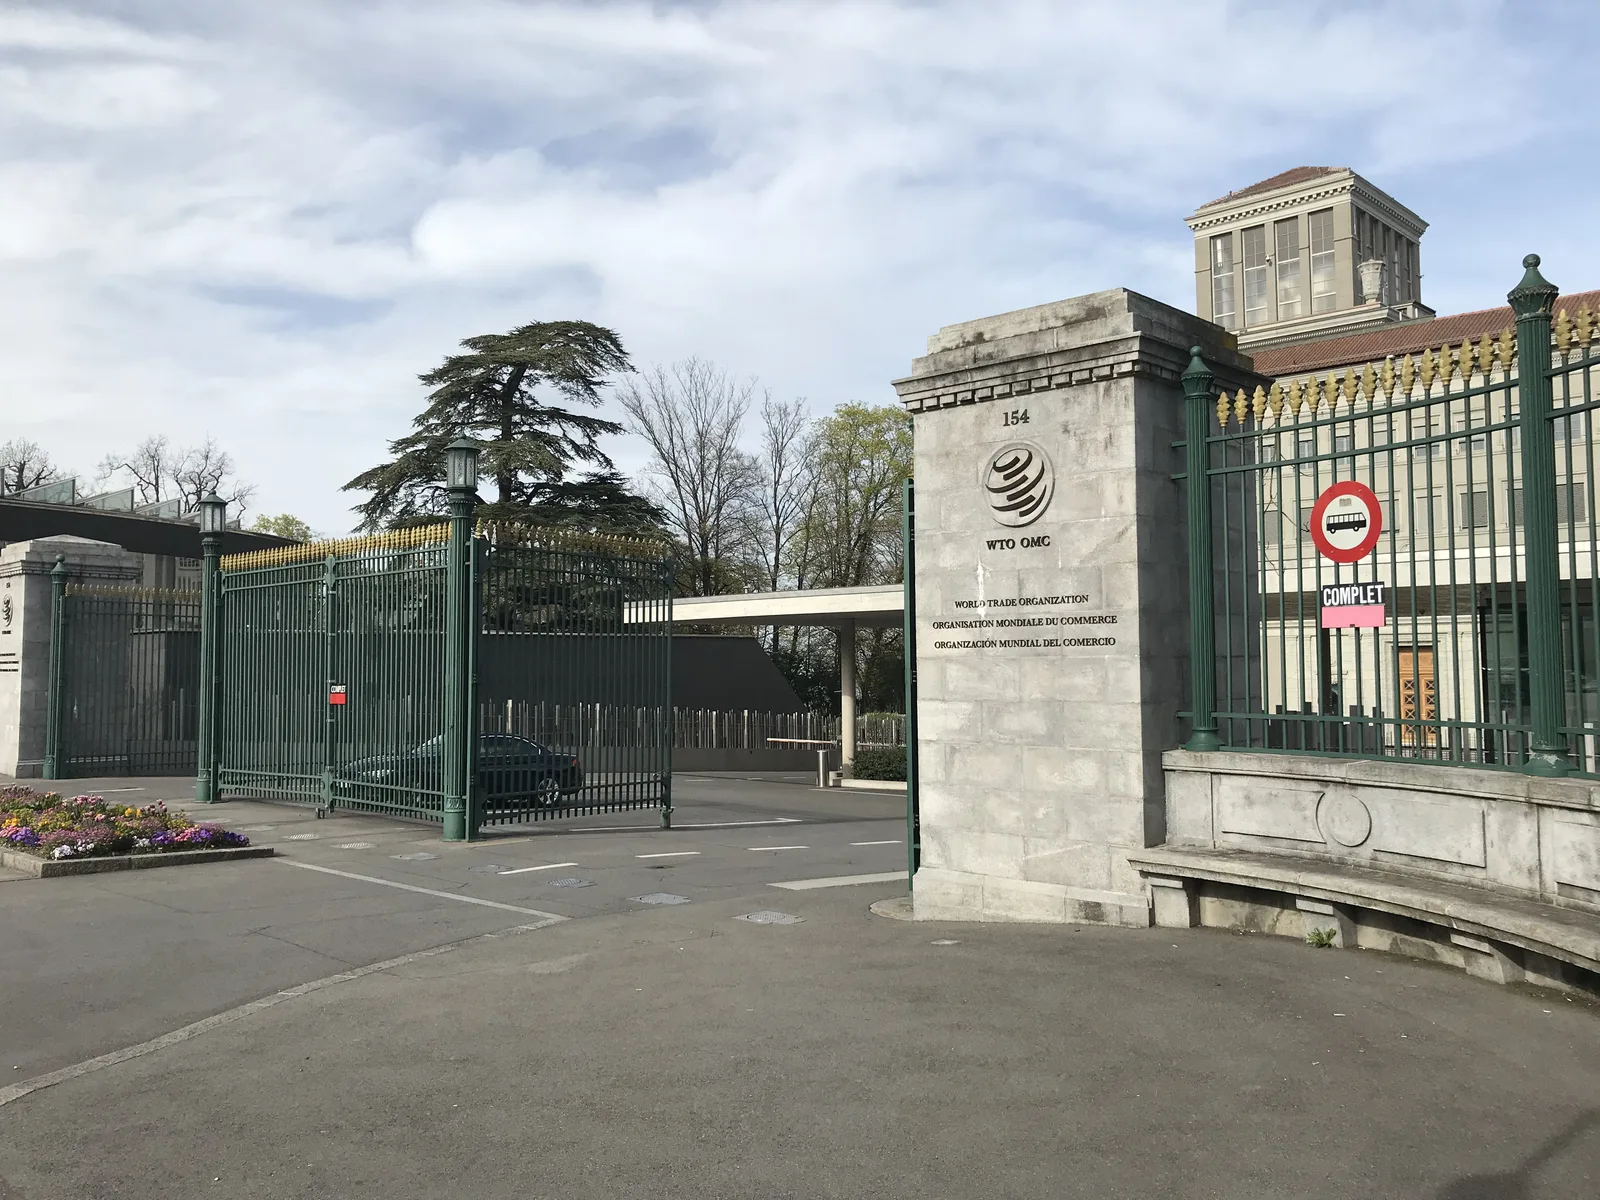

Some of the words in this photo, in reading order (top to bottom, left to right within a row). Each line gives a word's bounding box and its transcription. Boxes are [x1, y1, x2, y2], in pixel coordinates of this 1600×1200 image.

[1003, 408, 1030, 427] 154
[986, 538, 1016, 550] WTO
[1020, 535, 1051, 549] OMC
[955, 600, 986, 609] WORLD
[987, 598, 1017, 607] TRADE
[1018, 594, 1089, 606] ORGANIZATION
[1323, 585, 1384, 606] COMPLET
[932, 619, 994, 630] ORGANISATION
[995, 617, 1044, 628] MONDIALE
[1045, 617, 1059, 626] DU
[1060, 615, 1118, 626] COMMERCE
[934, 638, 997, 649] ORGANIZACIÓN
[999, 639, 1041, 648] MUNDIAL
[1043, 638, 1061, 648] DEL
[1063, 637, 1116, 647] COMERCIO
